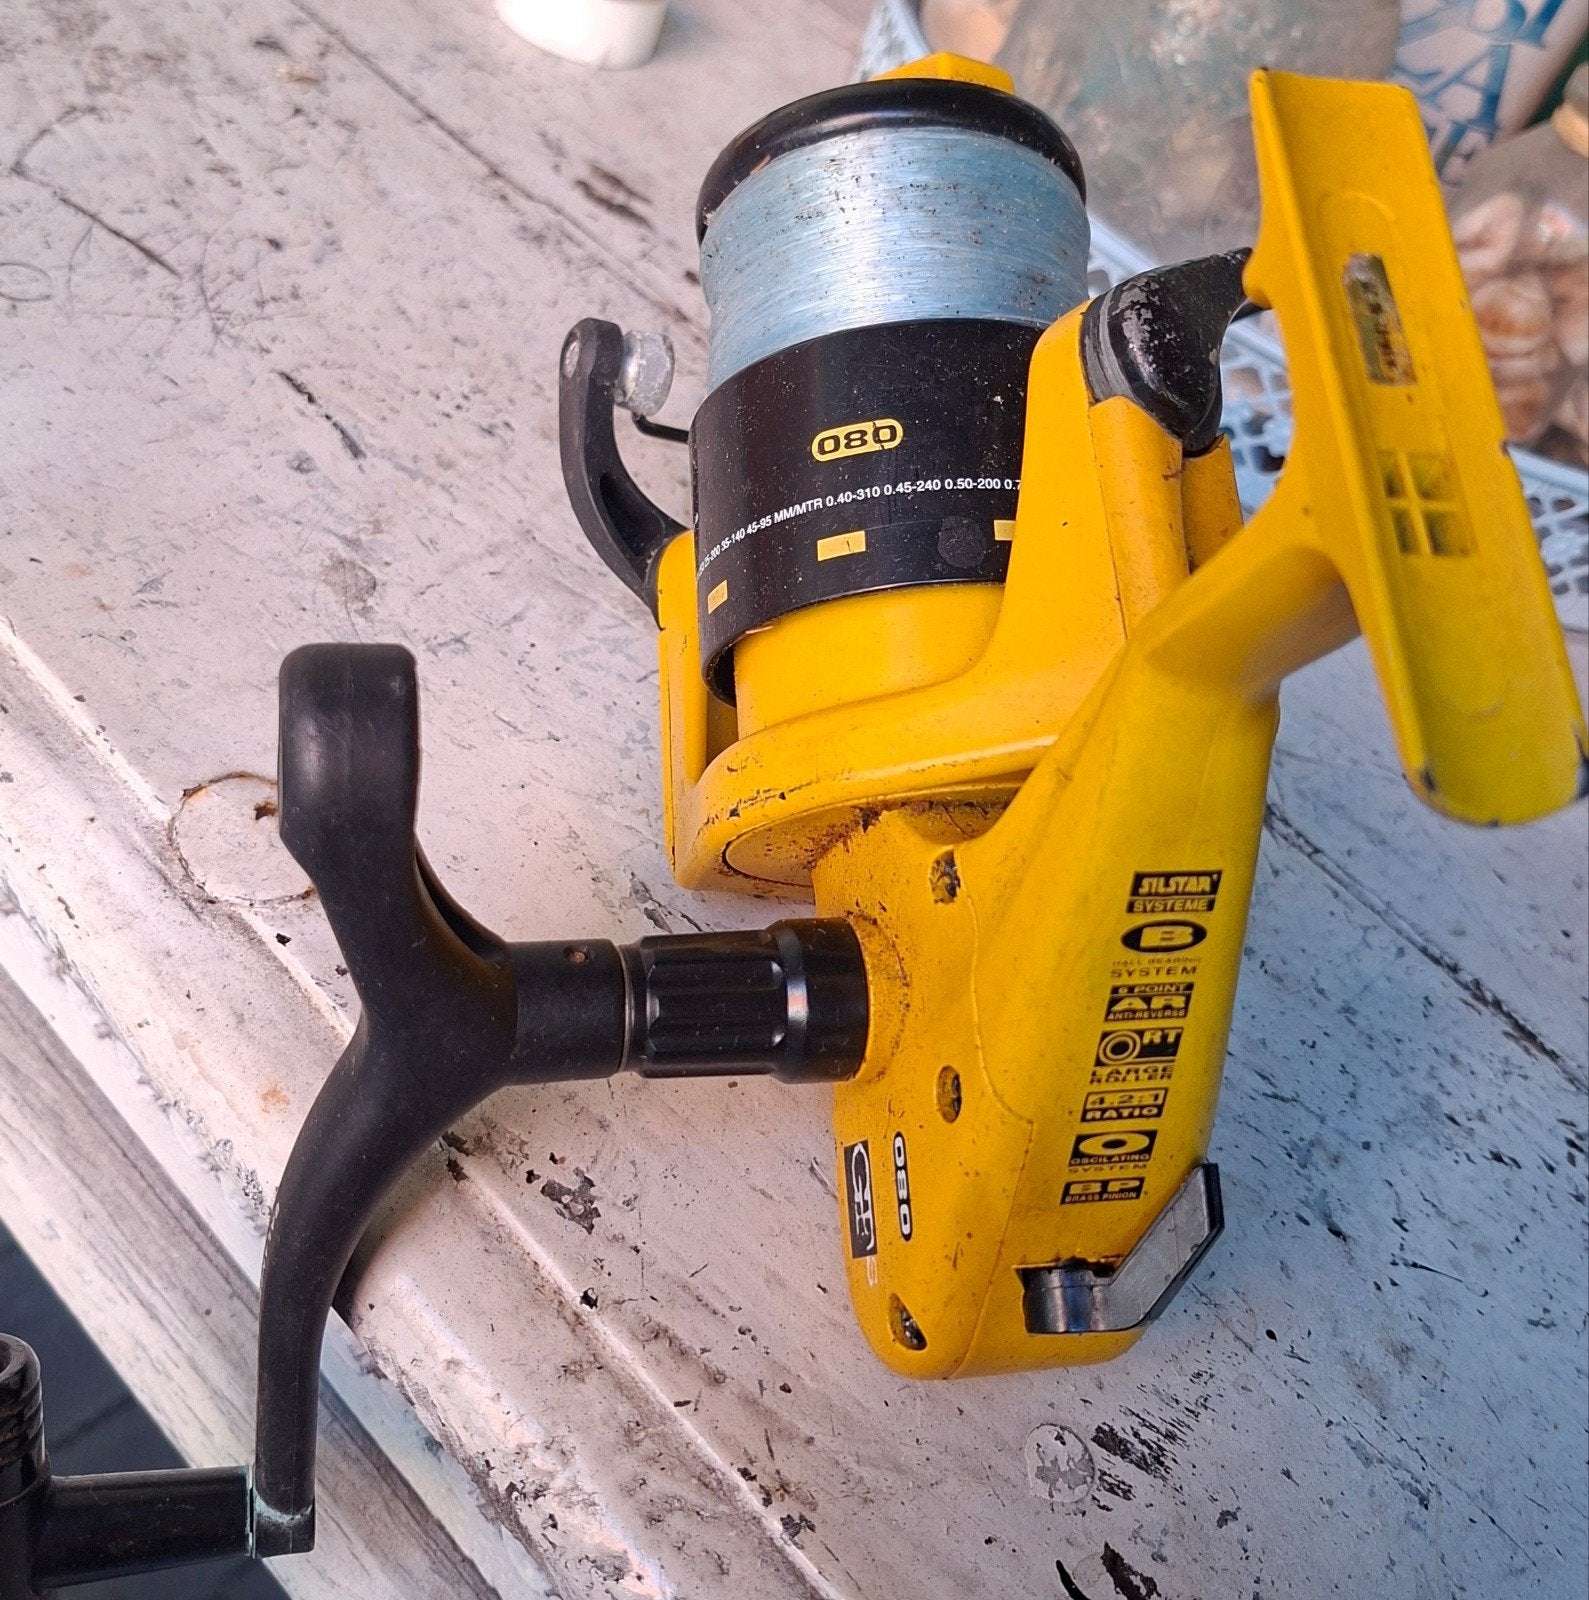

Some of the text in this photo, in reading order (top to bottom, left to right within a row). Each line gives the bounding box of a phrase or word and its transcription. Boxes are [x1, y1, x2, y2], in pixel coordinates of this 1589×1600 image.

[816, 424, 898, 456] 080
[746, 515, 772, 534] 45-95
[773, 497, 824, 524] MM/MTR
[825, 486, 881, 507] 0.40-310
[883, 478, 942, 495] 0.45-240
[944, 478, 1001, 490] 0.50-200
[1138, 874, 1212, 895] SILSTAR
[1132, 899, 1208, 912] SYSTEME
[1139, 925, 1194, 949] B
[1110, 966, 1197, 977] SYSTEM
[1133, 984, 1187, 993] POINT
[1110, 995, 1187, 1012] AR
[1107, 1009, 1186, 1019] ANTI-REVERSE
[1090, 1065, 1175, 1077] LARGE
[1089, 1074, 1172, 1085] ROLLER
[1090, 1092, 1160, 1105] 4.2:1
[1085, 1106, 1159, 1119] RATIO
[894, 1136, 911, 1235] 080
[1069, 1179, 1141, 1195] BP
[1065, 1191, 1138, 1203] BRASS PINION
